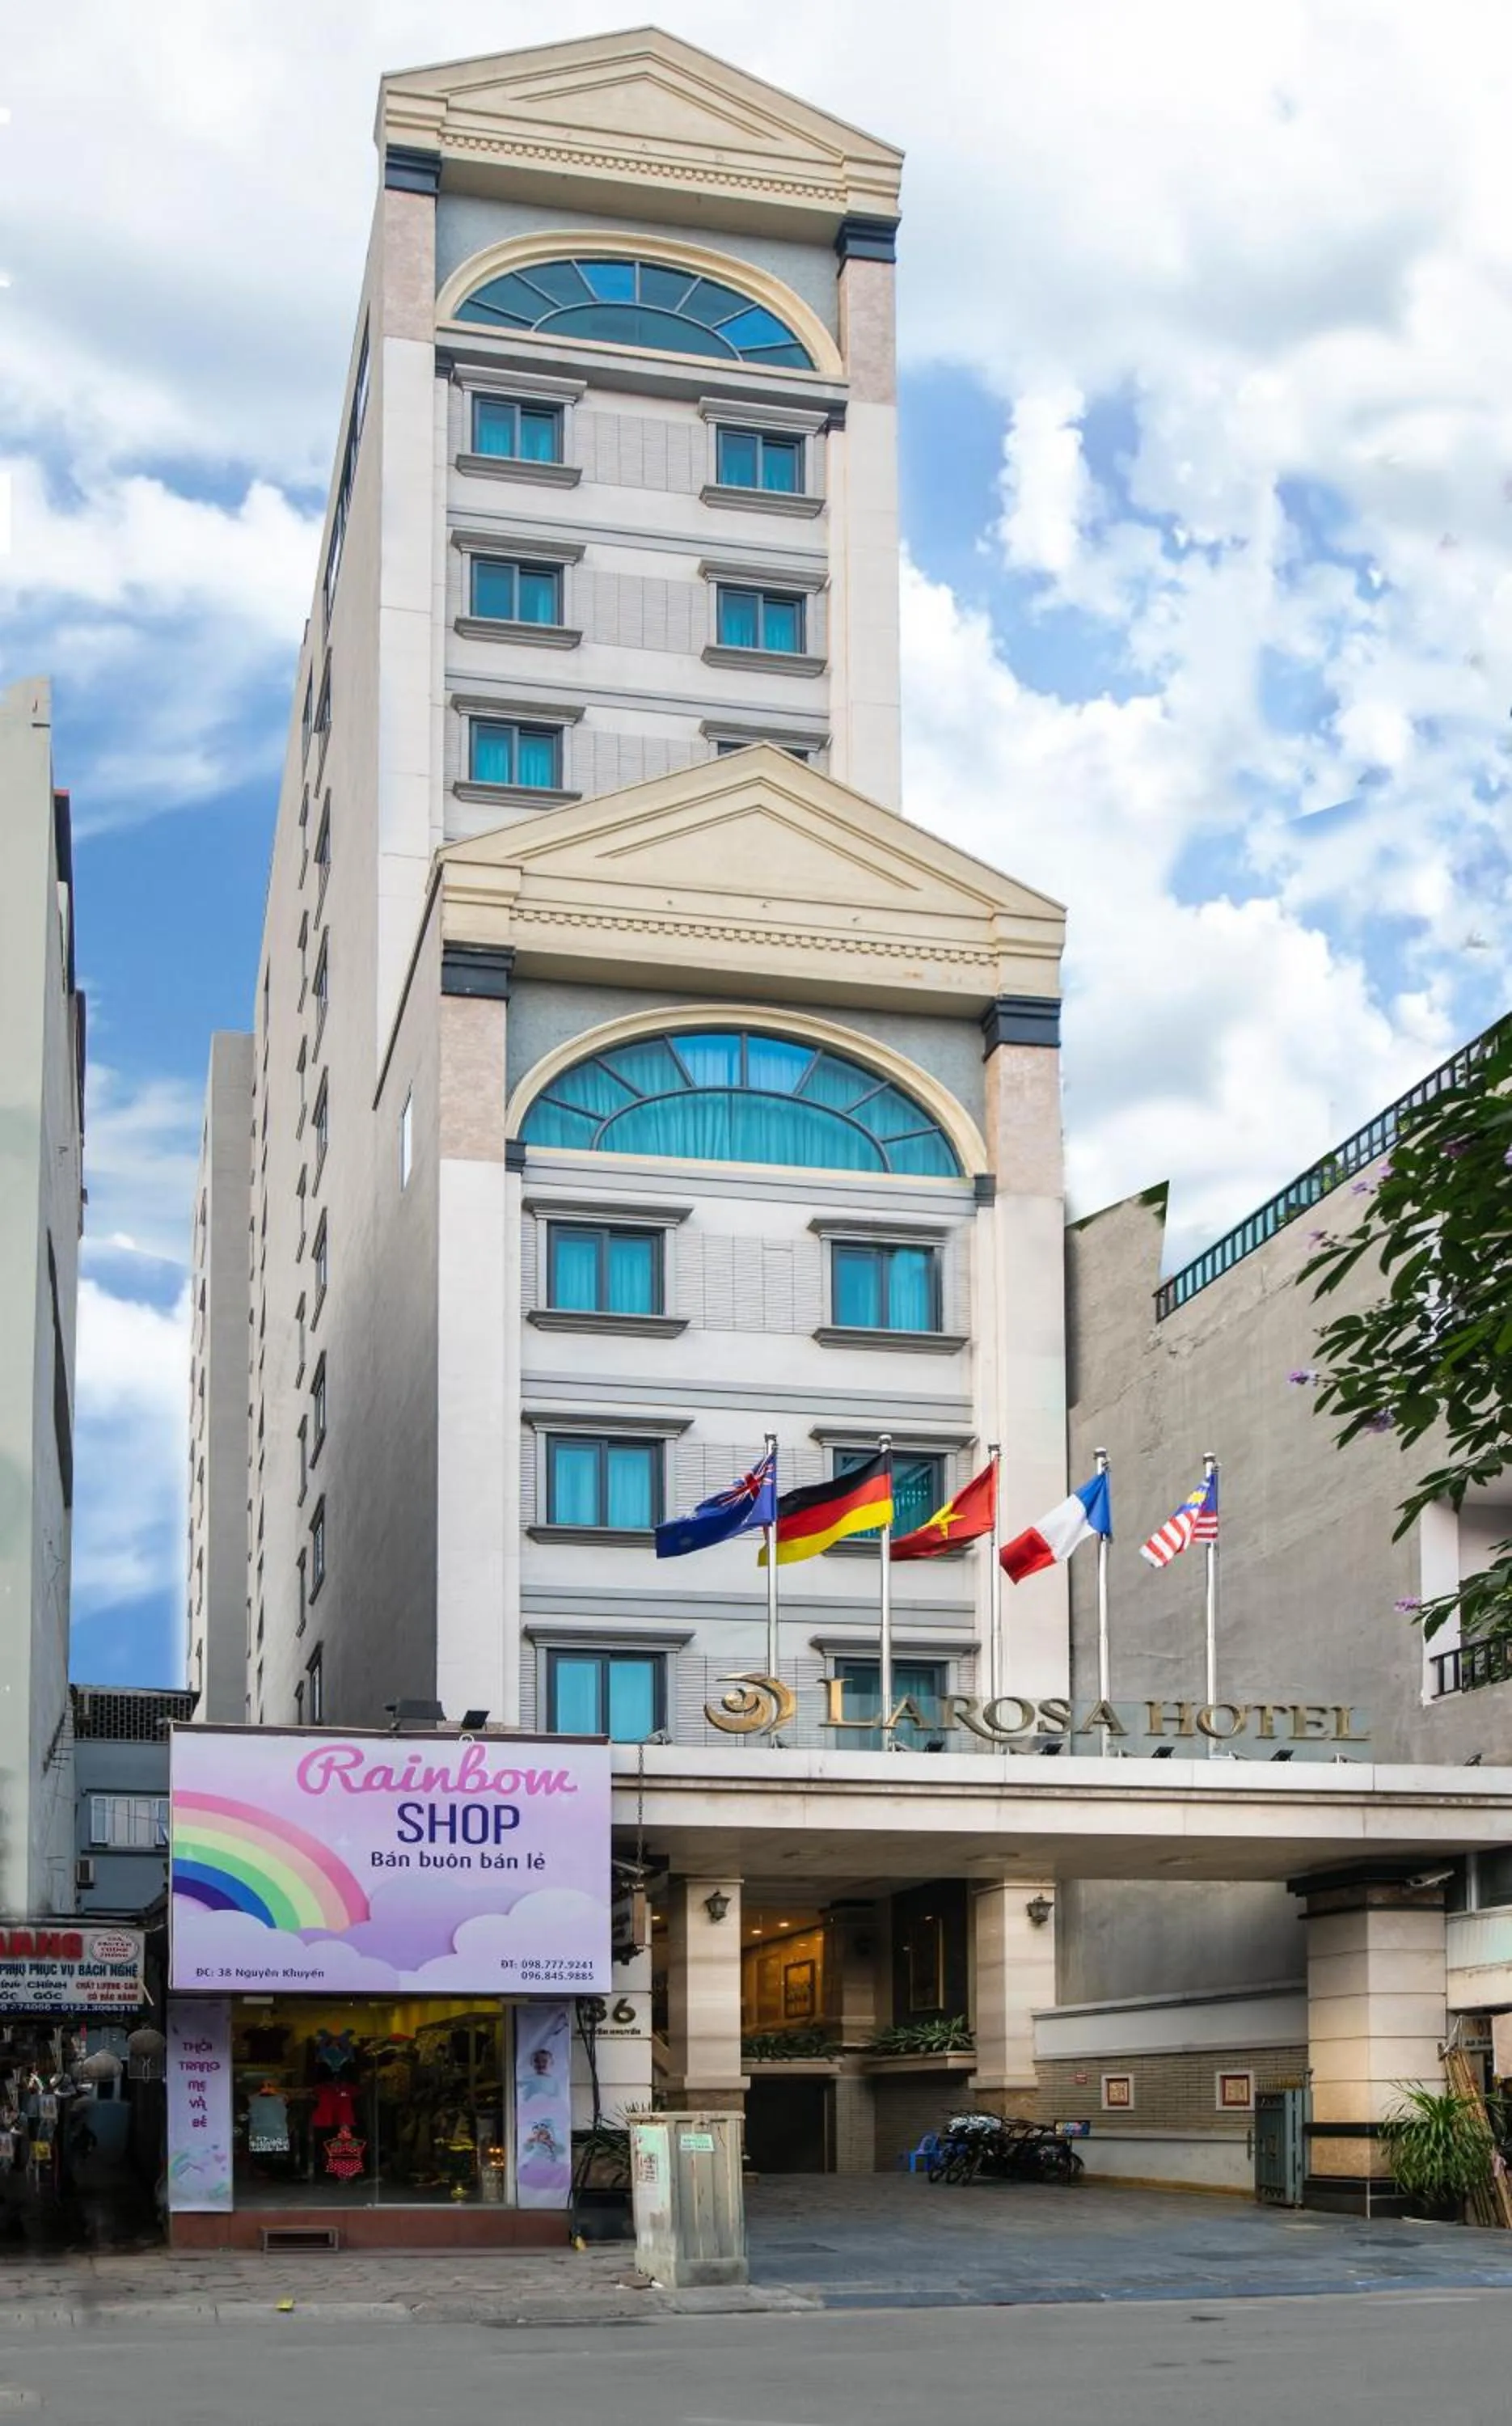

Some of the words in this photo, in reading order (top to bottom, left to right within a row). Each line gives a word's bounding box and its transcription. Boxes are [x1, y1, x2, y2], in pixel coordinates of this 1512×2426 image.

[1143, 1700, 1372, 1740] HOTEL
[297, 1743, 578, 1795] Rainbow
[397, 1803, 520, 1845] SHOP
[371, 1851, 410, 1868] Bán
[419, 1850, 471, 1869] buôn
[480, 1852, 518, 1870] bán
[218, 1967, 232, 1977] 38
[522, 1959, 593, 1969] 098.777.9241
